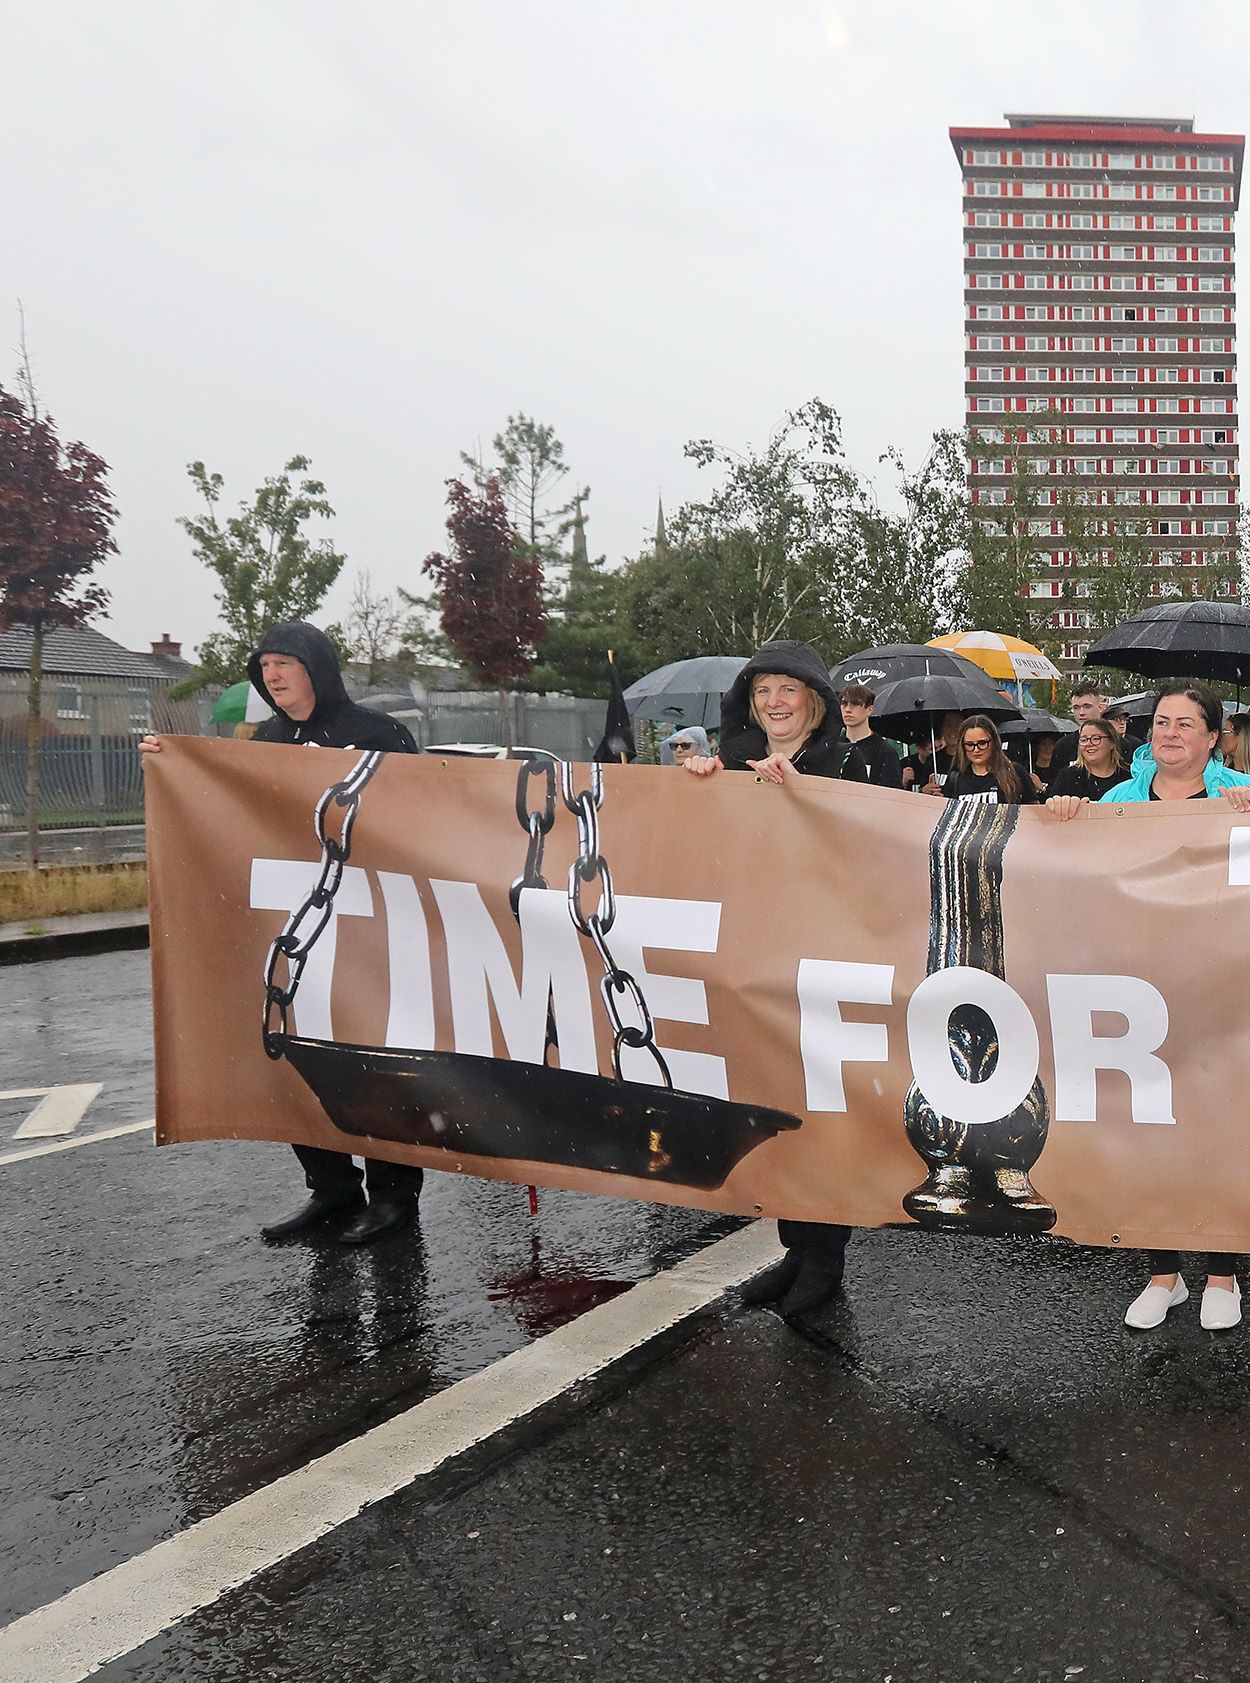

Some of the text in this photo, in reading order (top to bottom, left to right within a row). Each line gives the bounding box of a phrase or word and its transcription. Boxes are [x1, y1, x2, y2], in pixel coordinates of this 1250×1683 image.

[843, 668, 887, 681] Callaway
[250, 858, 730, 1102] TIME
[797, 958, 1177, 1125] FOR
